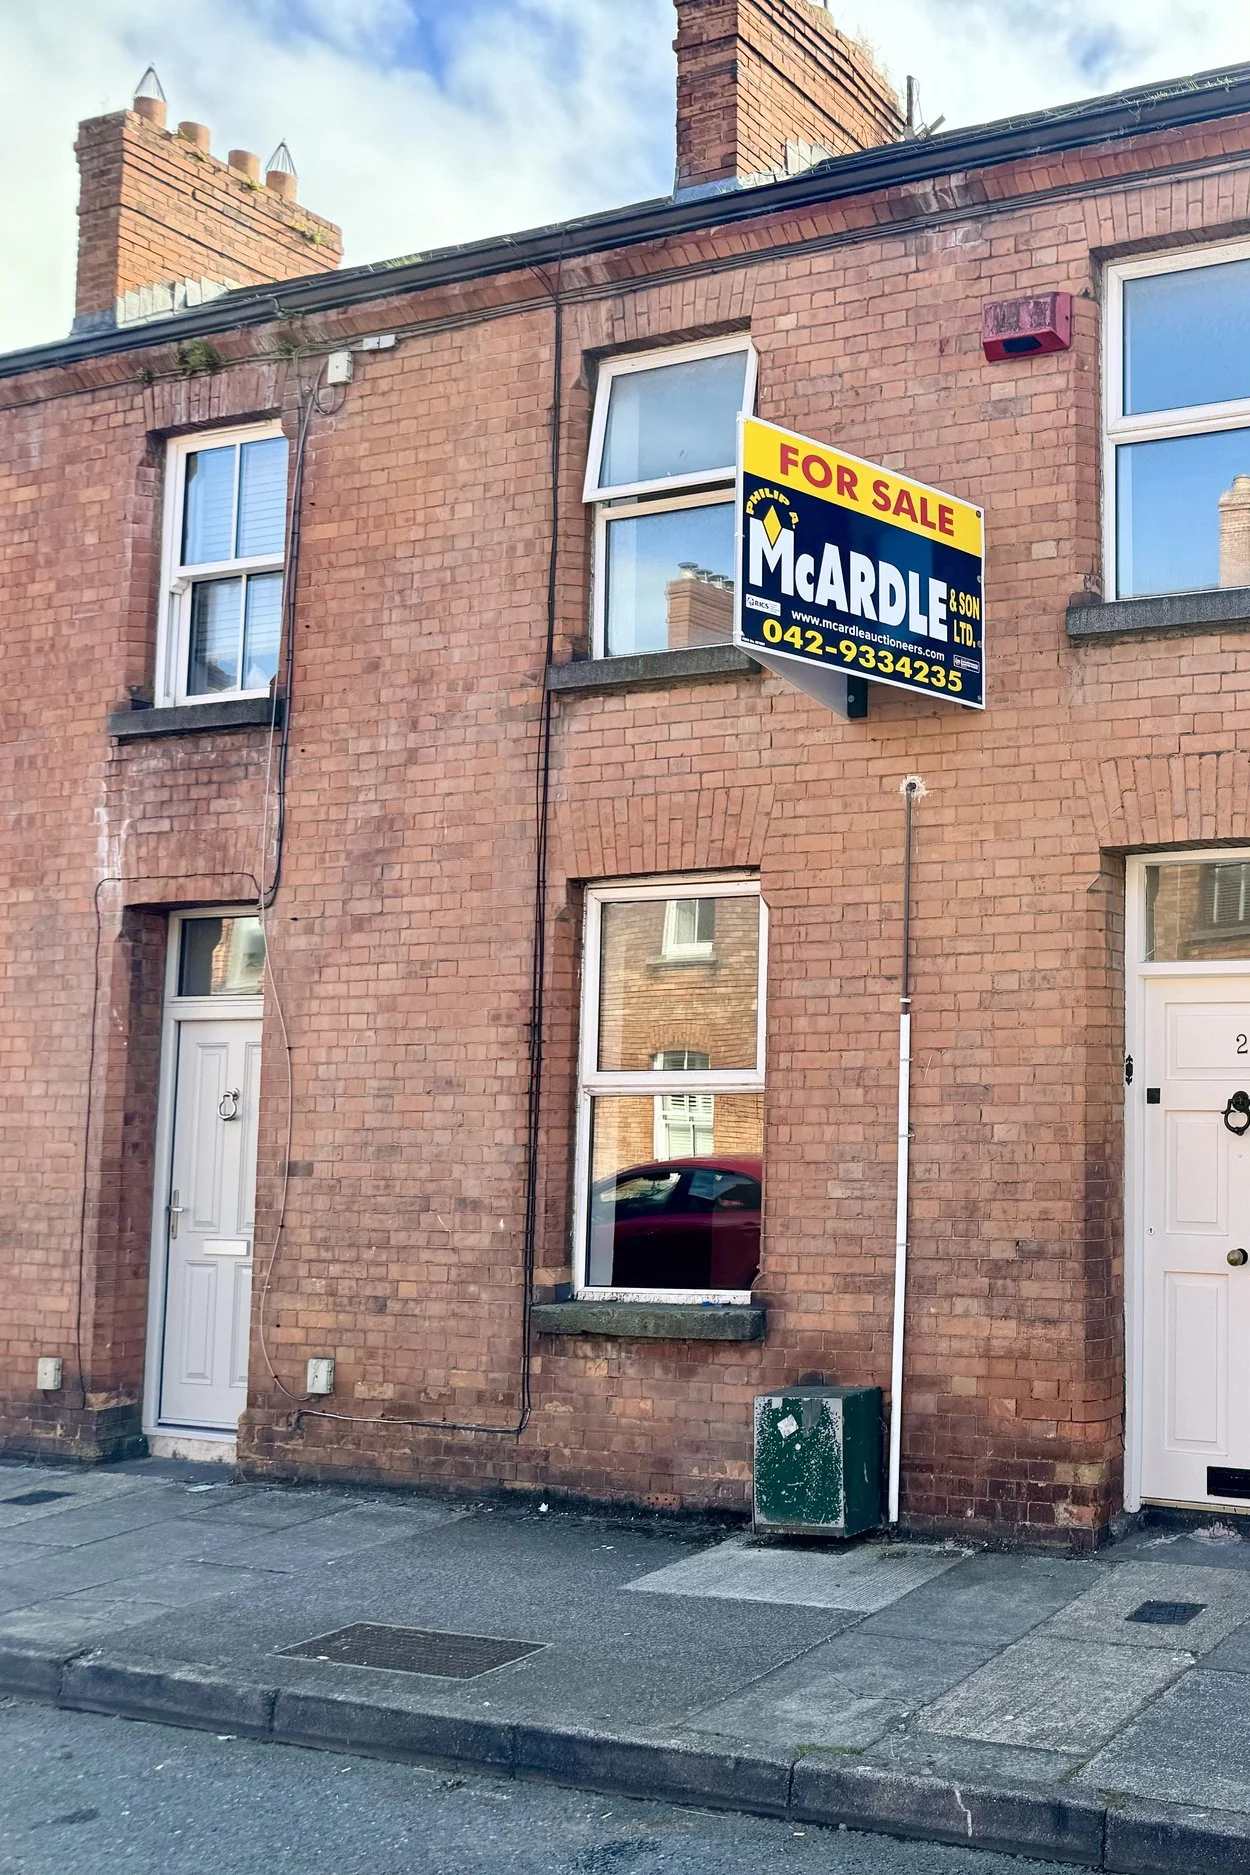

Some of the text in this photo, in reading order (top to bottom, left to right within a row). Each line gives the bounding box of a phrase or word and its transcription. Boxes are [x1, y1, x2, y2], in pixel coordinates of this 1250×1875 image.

[745, 488, 790, 515] PHILIP
[780, 443, 954, 536] FOR SALE
[949, 588, 980, 620] & SON
[791, 609, 945, 661] www.mcardleauctioneers.com
[953, 620, 976, 648] LTD.
[762, 618, 963, 692] 042-9334235
[1236, 1033, 1248, 1054] 2
